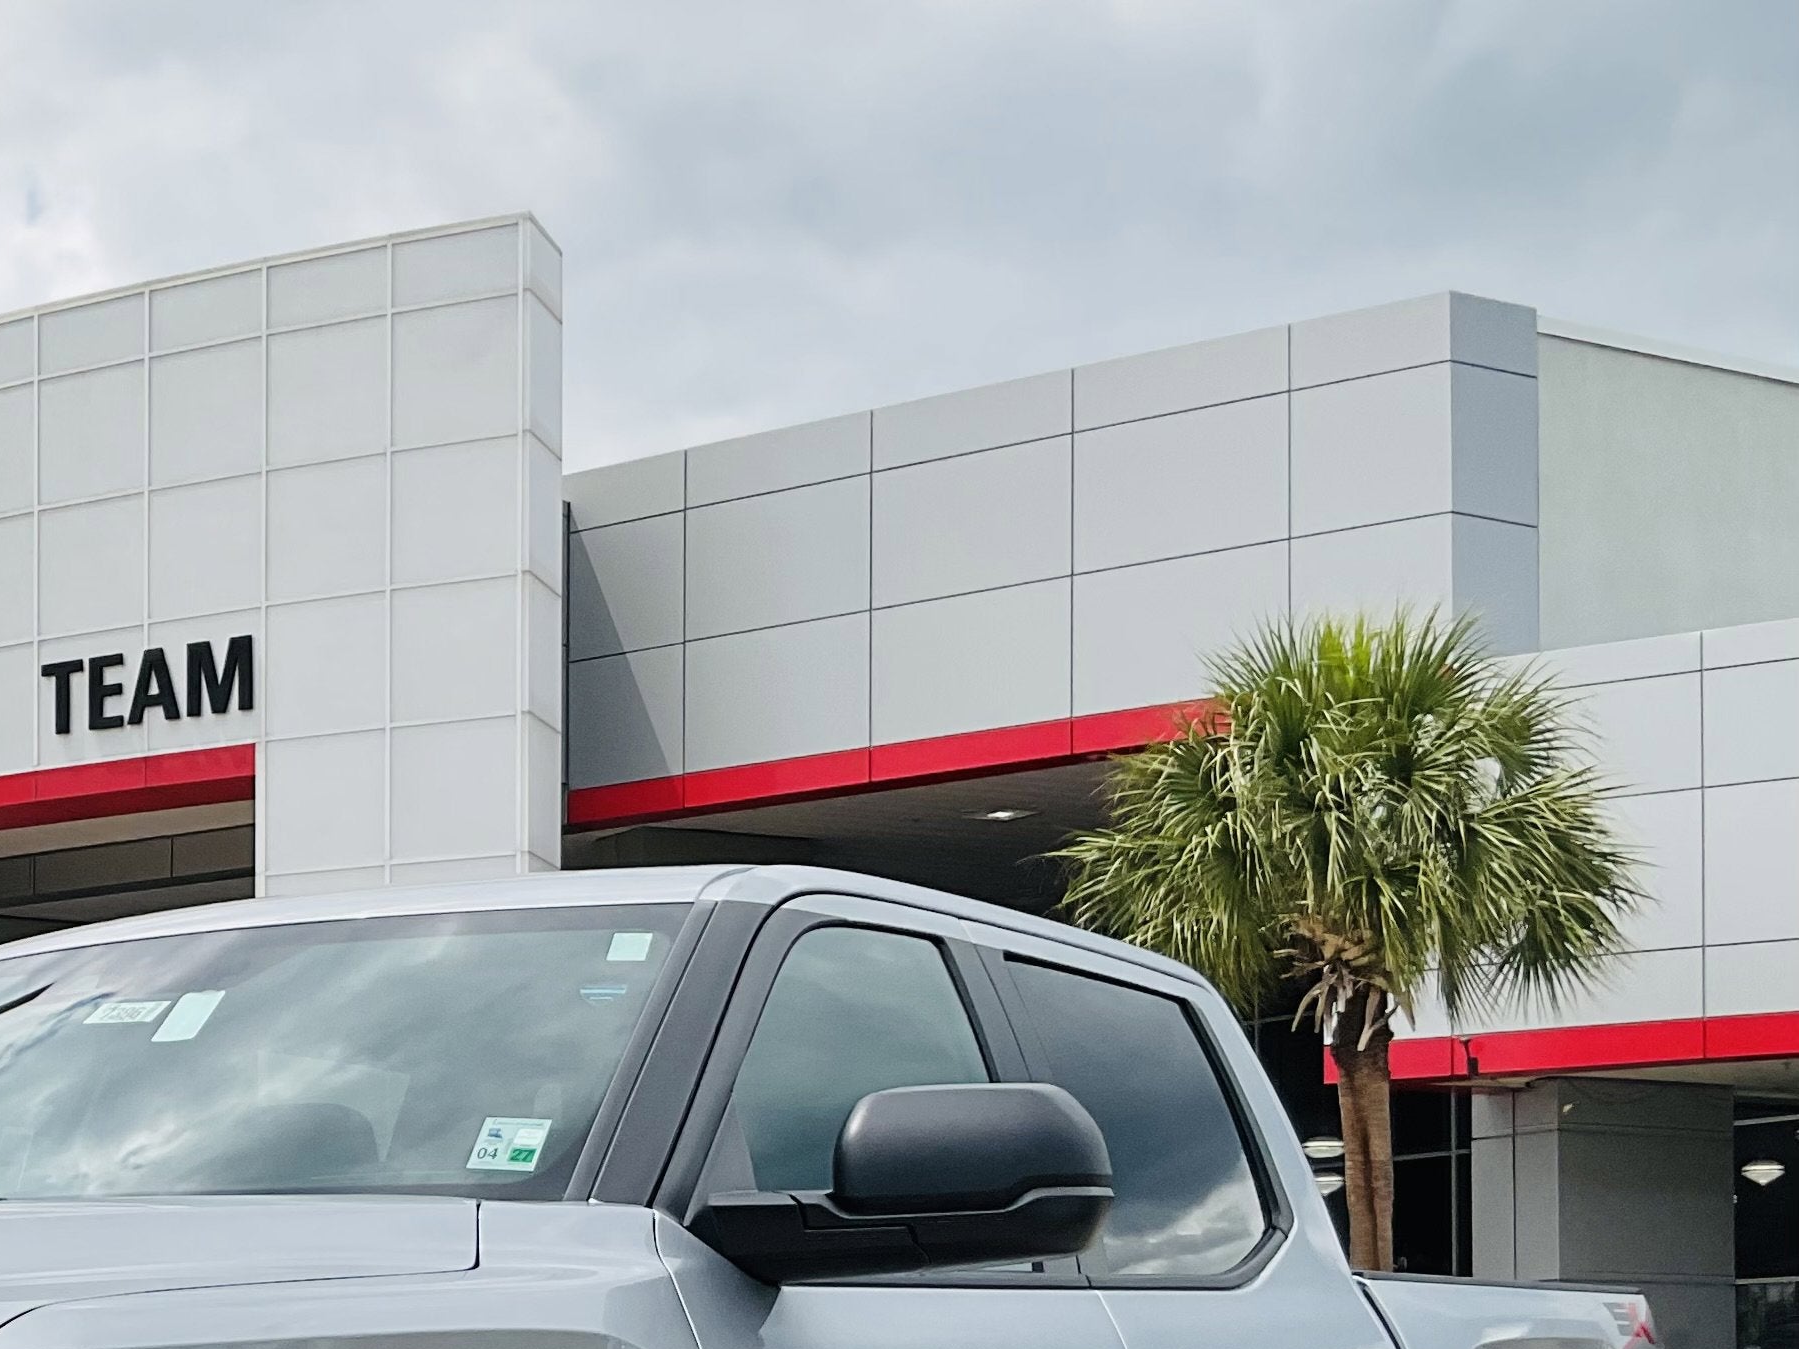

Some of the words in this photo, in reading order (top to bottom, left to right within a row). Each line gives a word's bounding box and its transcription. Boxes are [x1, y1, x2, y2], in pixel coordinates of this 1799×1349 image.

[41, 635, 255, 735] TEAM
[477, 1147, 499, 1160] 04
[509, 1148, 537, 1163] 27
